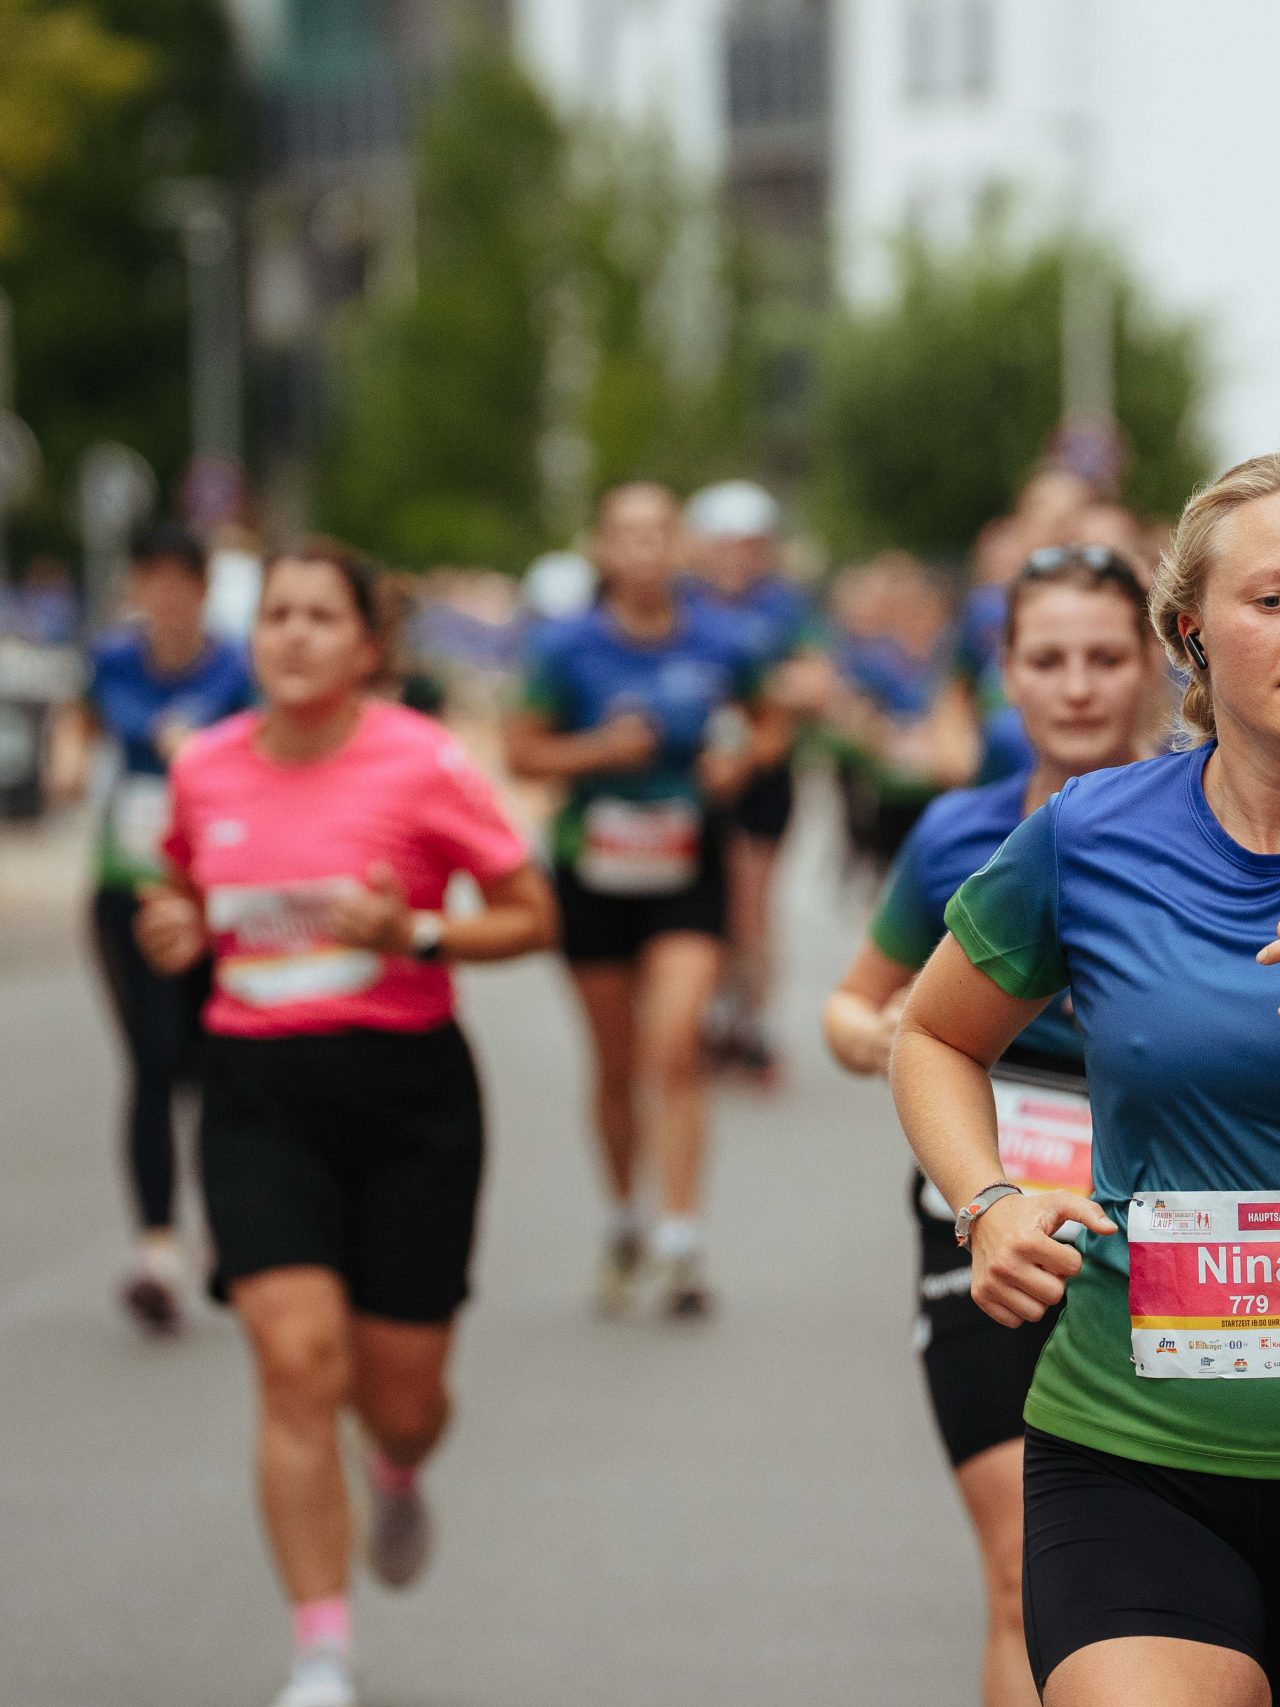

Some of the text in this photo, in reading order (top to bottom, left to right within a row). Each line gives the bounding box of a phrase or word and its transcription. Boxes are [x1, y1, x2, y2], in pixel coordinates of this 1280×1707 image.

[1152, 1220, 1172, 1228] LAUF
[1229, 1294, 1269, 1314] 779
[1221, 1318, 1280, 1328] STARTZEIT 18:00 UHR
[1159, 1338, 1175, 1348] dm
